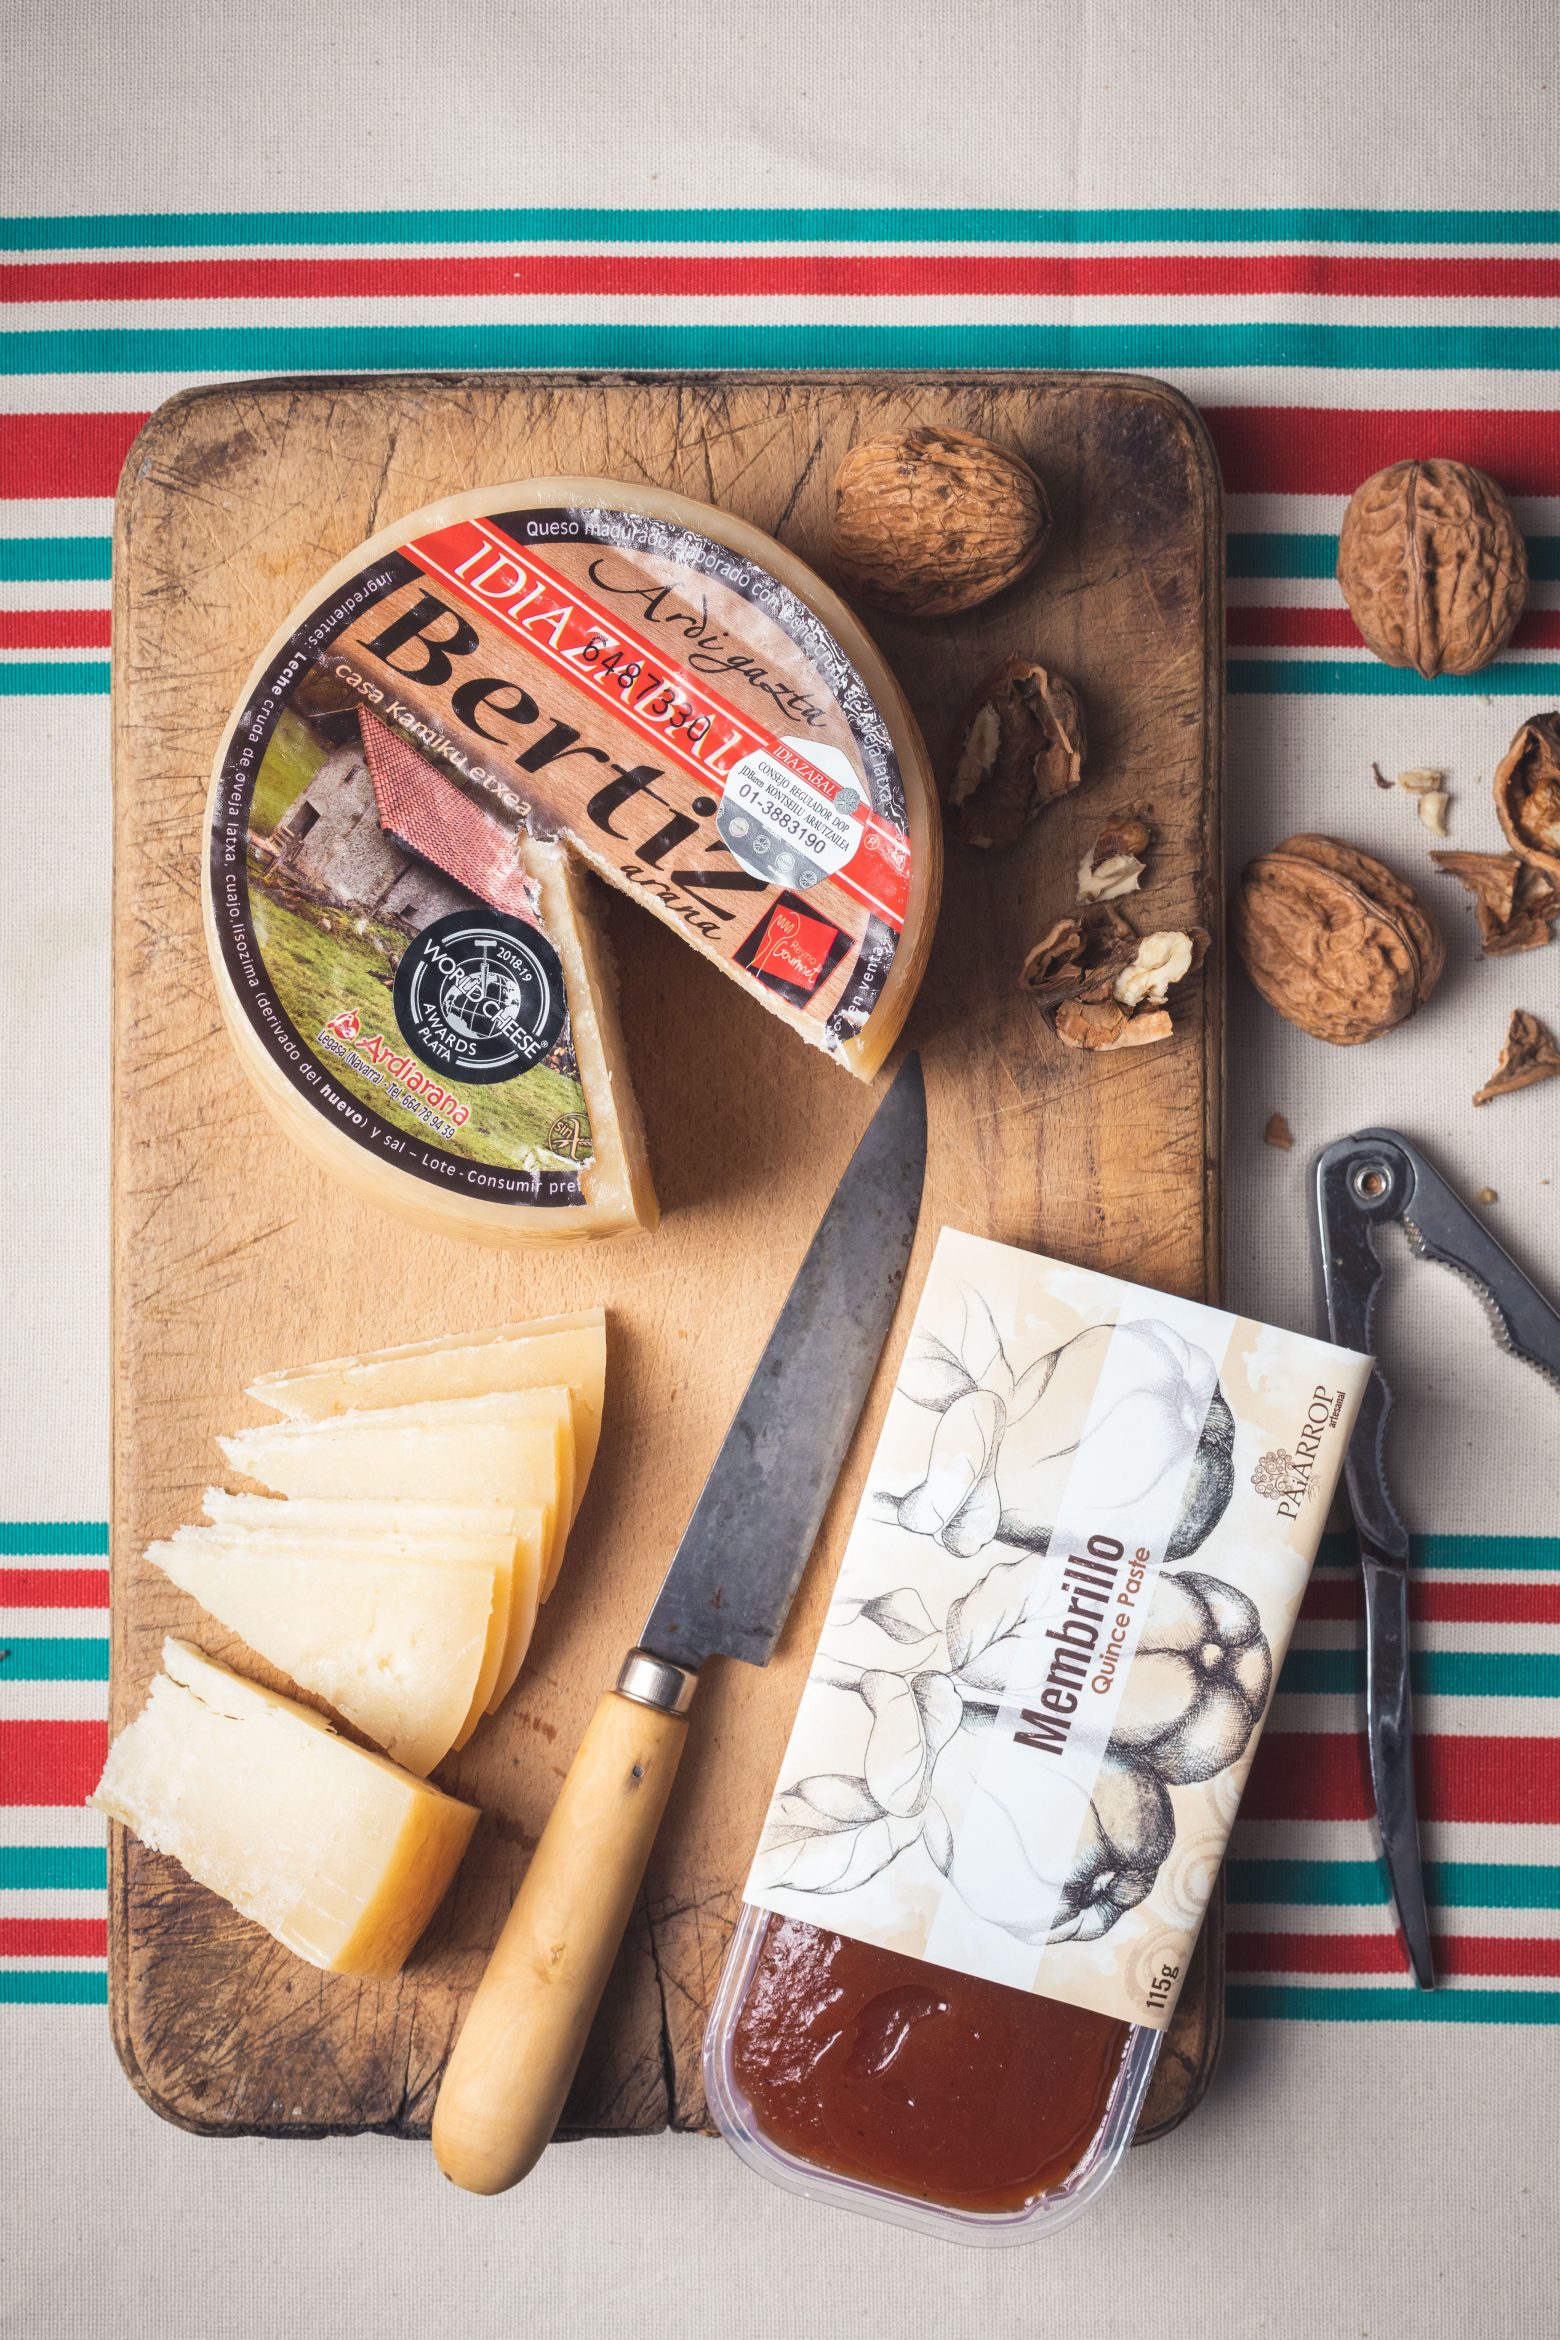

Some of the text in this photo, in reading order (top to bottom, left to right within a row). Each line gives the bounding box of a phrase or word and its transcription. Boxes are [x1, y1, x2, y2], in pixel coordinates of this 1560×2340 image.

[304, 571, 394, 650] Ingredientes:
[271, 651, 308, 696] Leche
[454, 540, 743, 777] IDIAZABAL
[526, 520, 579, 537] Queso
[584, 522, 668, 549] madurado
[673, 537, 750, 587] elaborado
[751, 583, 780, 608] con
[873, 763, 892, 803] latxa
[582, 635, 712, 742] 6487330
[248, 699, 274, 743] cruda
[335, 664, 386, 704] casa
[468, 764, 533, 816] etxea
[239, 747, 254, 767] de
[356, 587, 771, 922] Bertiz
[773, 745, 837, 797] IDIAZABAL
[228, 772, 247, 816] oveja
[738, 765, 765, 788] JDBaren
[765, 784, 805, 818] KONTSEILU
[803, 814, 850, 852] ARAUTZAILEA
[739, 783, 826, 854] 01-3883190
[758, 761, 850, 833] CONSEJO REGULADOR DOP
[224, 823, 239, 867] latxa,
[620, 864, 721, 941] arana
[423, 938, 486, 1003] WORLD
[496, 947, 533, 982] 2018-19
[772, 940, 823, 984] Gourmet
[789, 940, 817, 965] Reyno
[858, 946, 885, 990] venta
[254, 992, 301, 1061] (derivado
[418, 1027, 452, 1062] PLATA
[423, 1003, 478, 1056] AWARDS
[299, 1061, 323, 1086] del
[316, 1030, 346, 1057] Legasa
[344, 1051, 385, 1085] (Navarra)
[387, 1082, 402, 1100] Tel.
[402, 1094, 420, 1113] 664
[418, 1106, 432, 1122] 78
[430, 1116, 443, 1132] 94
[442, 1127, 456, 1140] 39
[356, 1035, 471, 1128] Ardiarana
[319, 1083, 369, 1129] huevo)
[554, 1120, 573, 1138] sin
[370, 1127, 381, 1139] y
[383, 1134, 407, 1154] sal
[1328, 1390, 1347, 1429] artesanal
[1013, 1534, 1125, 1756] Membrillo
[1091, 1547, 1151, 1694] Quince Paste
[1146, 1963, 1180, 2009] 115g
